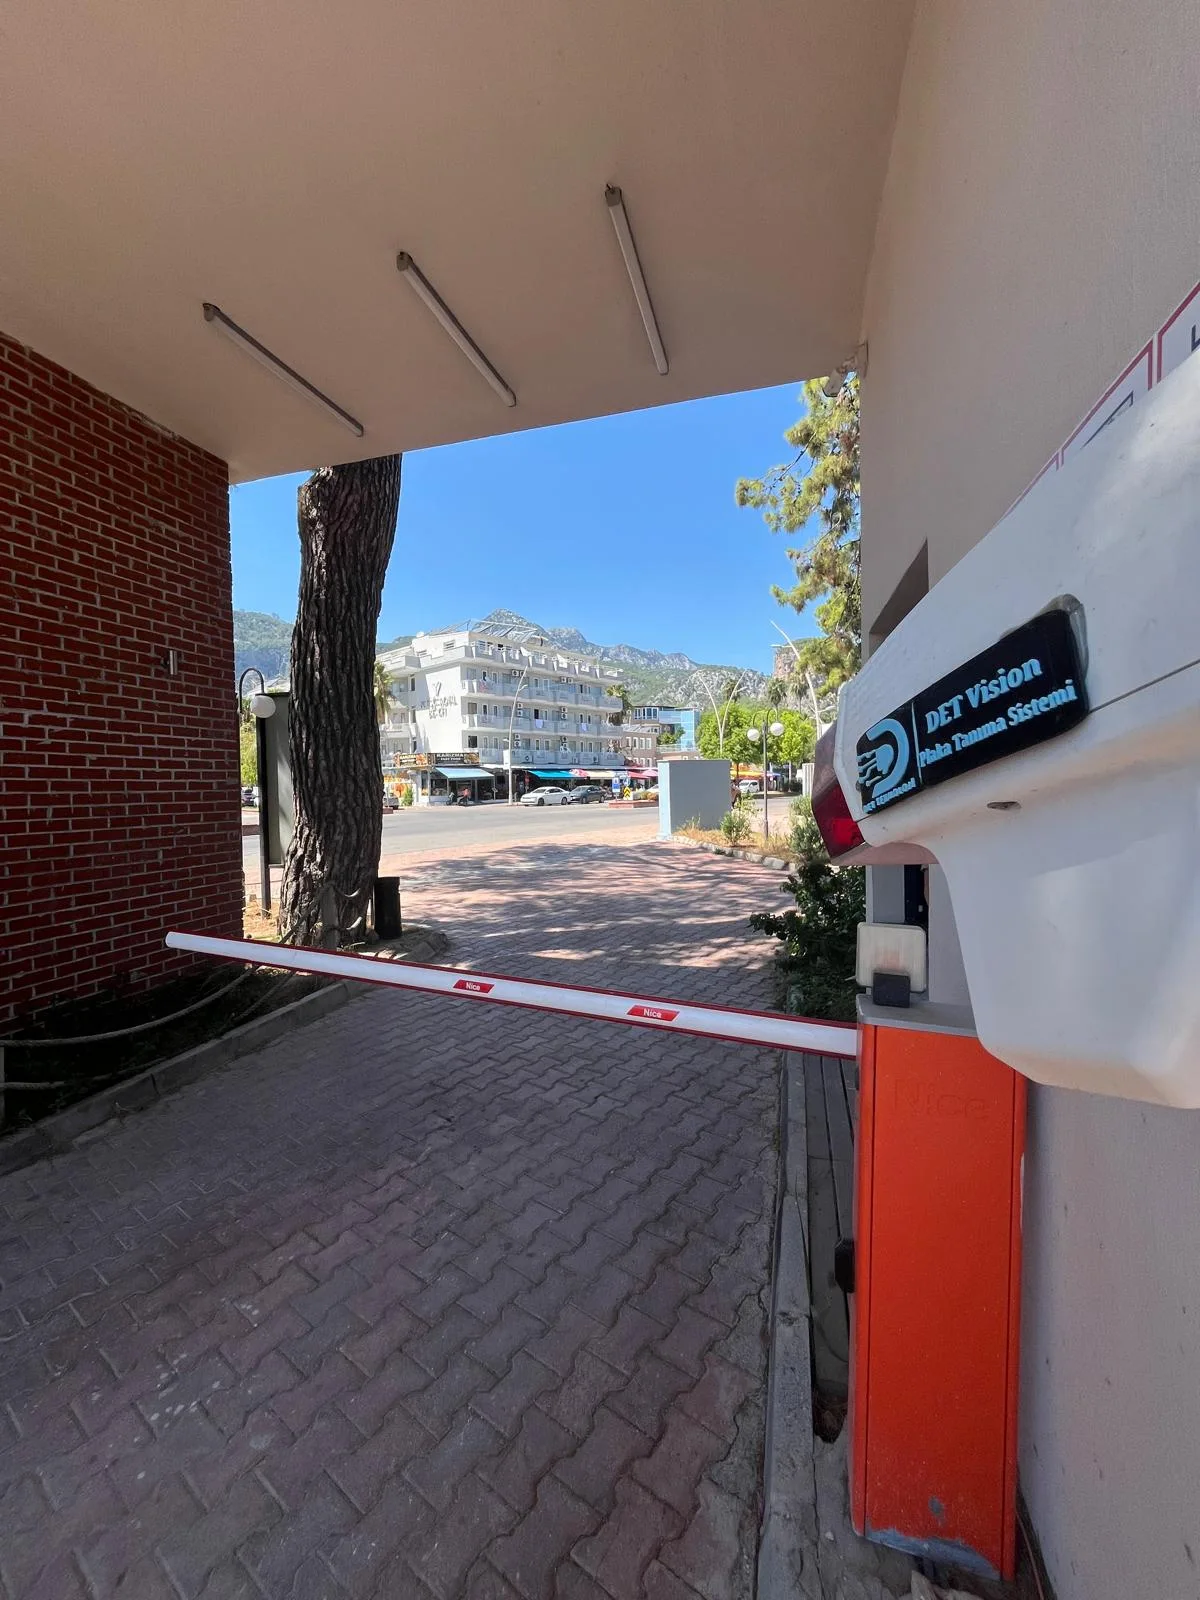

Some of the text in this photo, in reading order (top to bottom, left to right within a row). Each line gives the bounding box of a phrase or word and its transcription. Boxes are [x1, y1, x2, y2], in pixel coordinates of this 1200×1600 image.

[925, 658, 1043, 733] DET Vision
[919, 742, 953, 768] Plaka
[1007, 679, 1078, 726] Sistemi
[465, 981, 481, 991] Nice
[643, 1008, 662, 1018] Nice
[894, 1079, 990, 1120] Nice
